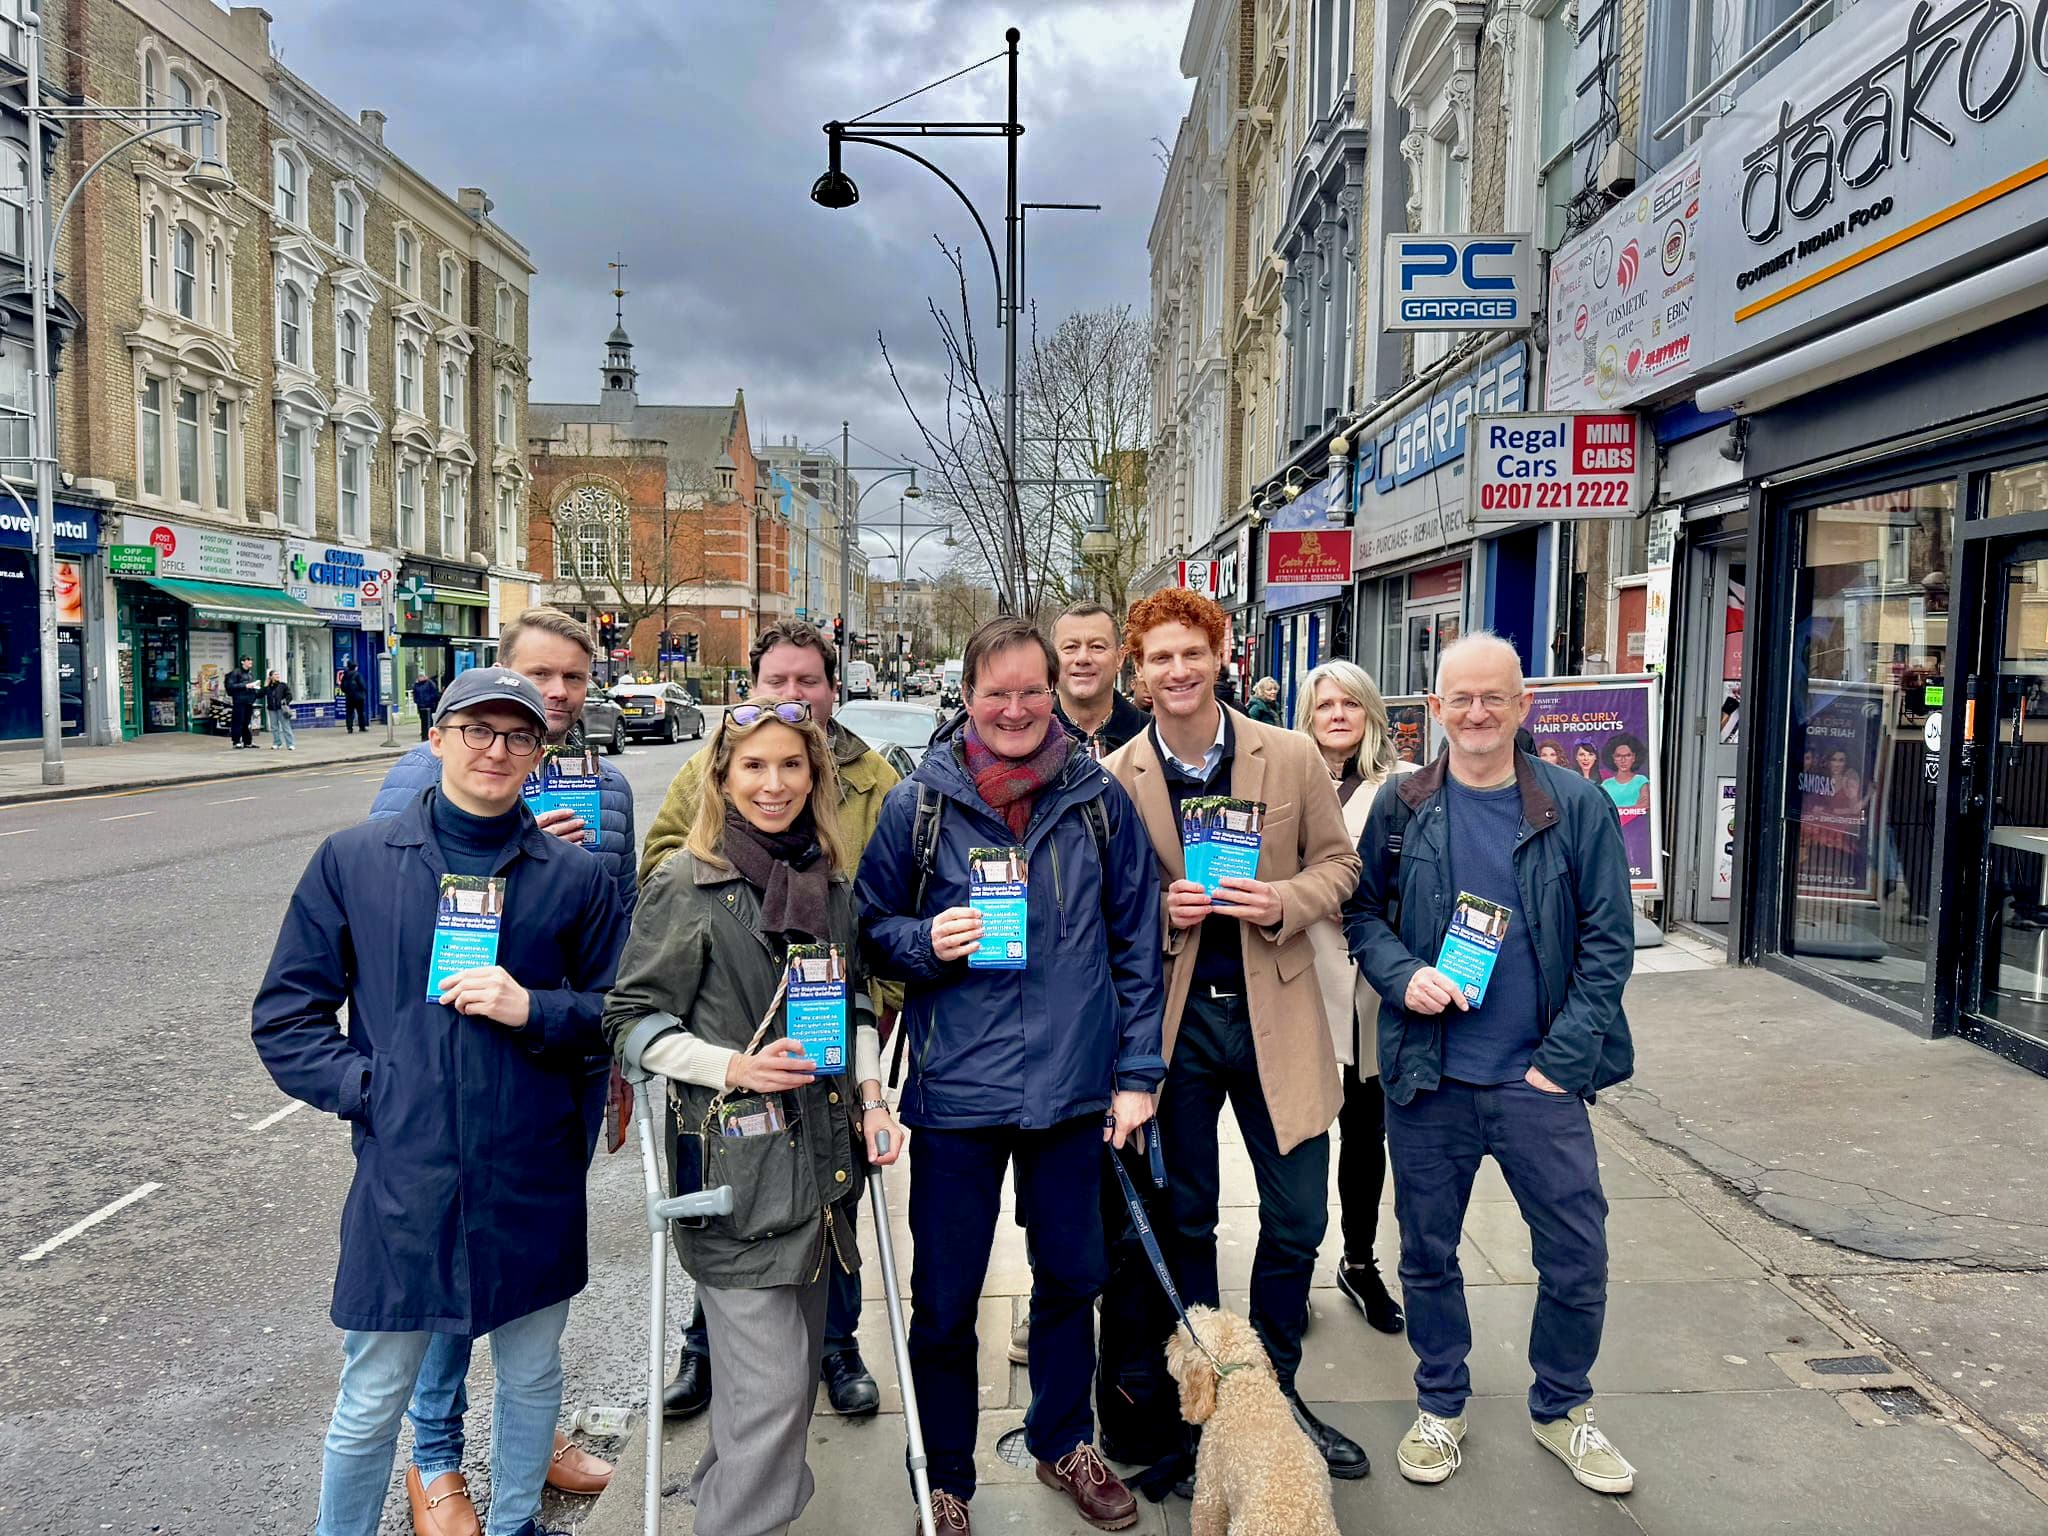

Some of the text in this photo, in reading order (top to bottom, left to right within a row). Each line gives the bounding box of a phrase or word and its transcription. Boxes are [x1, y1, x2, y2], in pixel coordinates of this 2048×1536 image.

[1654, 180, 1683, 213] ECO
[1736, 196, 1894, 291] GOURMET INDIAN FOOD
[1400, 243, 1517, 291] PC
[1405, 301, 1513, 318] GARAGE
[1606, 290, 1649, 327] COSMETIC
[1667, 300, 1690, 323] EBIN
[1617, 320, 1634, 339] cave
[1396, 352, 1522, 476] GARAGE
[1490, 423, 1566, 455] Regal
[1586, 424, 1630, 444] MINI
[1497, 455, 1557, 479] Cars
[1582, 448, 1633, 469] CABS
[1481, 480, 1629, 511] 0207 221 2222
[155, 533, 170, 542] POST
[1376, 529, 1408, 555] PURCHASE
[1414, 518, 1439, 543] REPAIR
[112, 554, 152, 563] LICENCE
[124, 547, 142, 555] OFF
[120, 562, 146, 570] OPEN
[161, 560, 185, 572] OFFICE
[309, 562, 379, 589] CHEMIST
[1218, 550, 1238, 599] KFC
[293, 587, 307, 599] NHS
[1534, 720, 1624, 734] HAIR PRODUCTS
[1539, 711, 1619, 724] AFRO & CURLY
[1798, 772, 1836, 797] SAMOSAS
